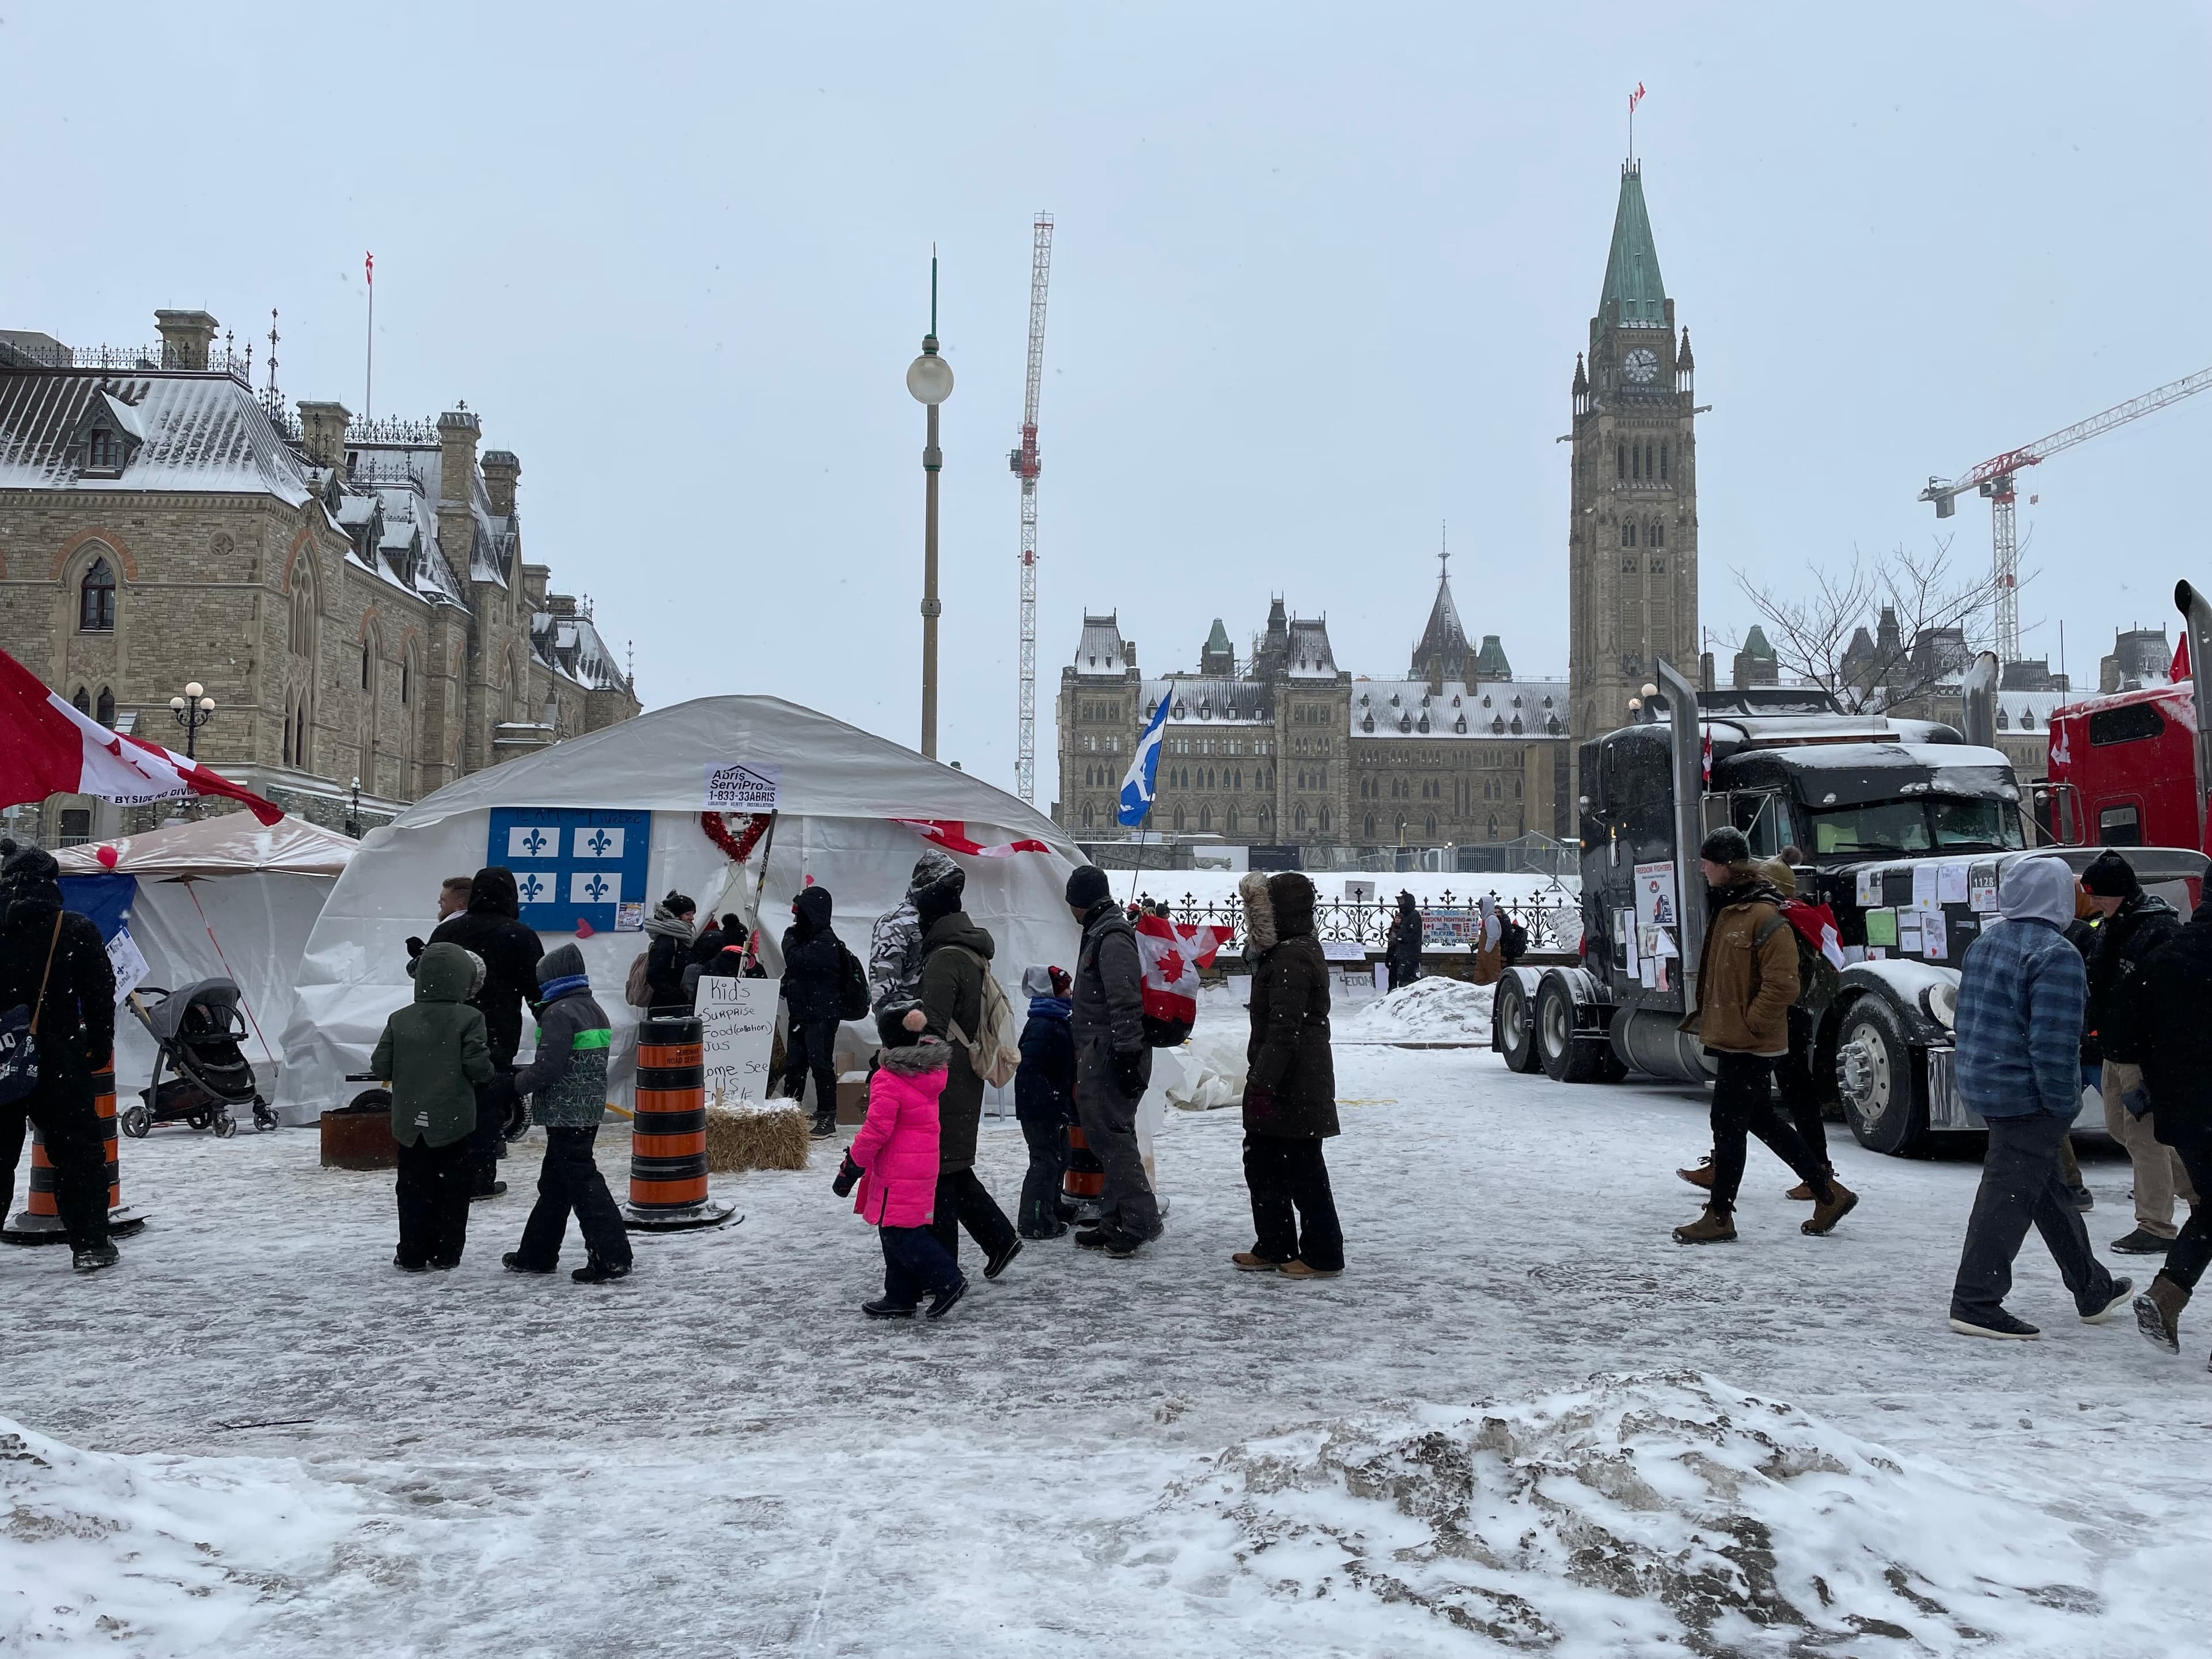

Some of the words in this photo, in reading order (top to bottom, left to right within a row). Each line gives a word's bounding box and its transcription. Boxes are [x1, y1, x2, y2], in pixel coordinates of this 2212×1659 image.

[713, 770, 745, 780] Abris
[115, 796, 130, 804] BY
[132, 794, 153, 804] SIDE
[155, 791, 167, 800] NO
[710, 790, 775, 802] 1-833-33ABRIS
[1974, 877, 1994, 887] 1128
[666, 1057, 683, 1065] ROAD
[744, 1060, 770, 1074] See
